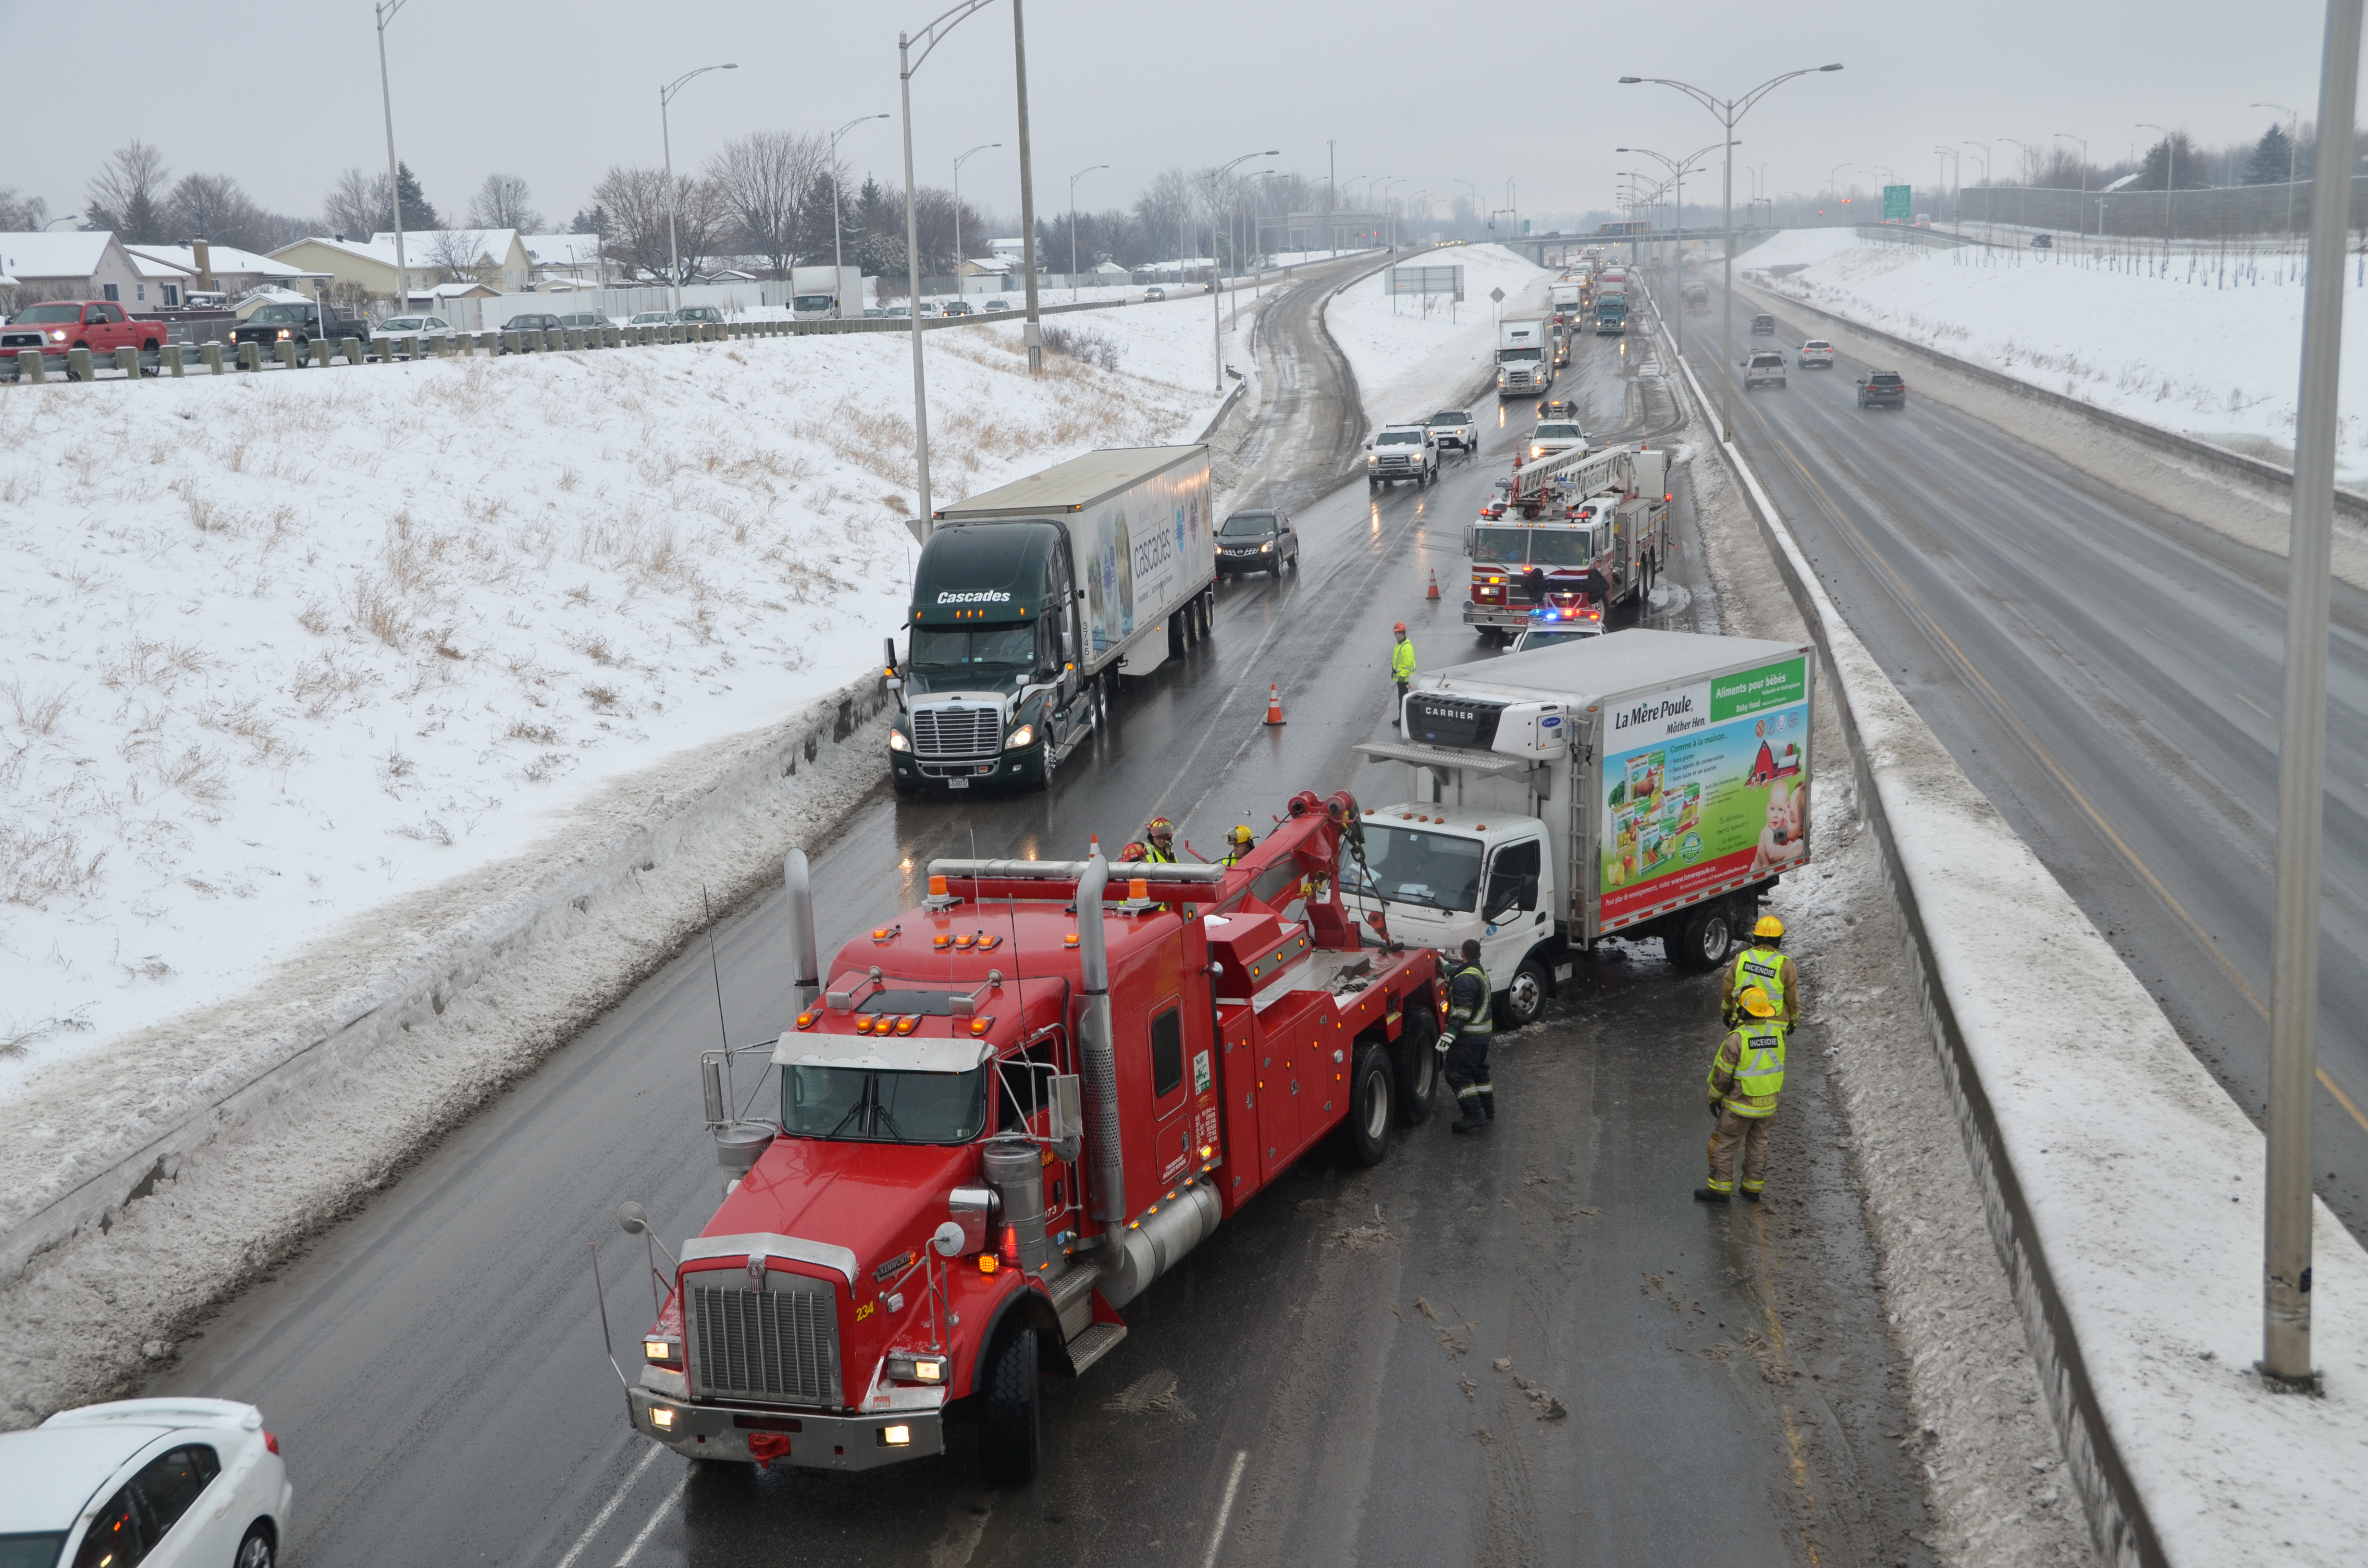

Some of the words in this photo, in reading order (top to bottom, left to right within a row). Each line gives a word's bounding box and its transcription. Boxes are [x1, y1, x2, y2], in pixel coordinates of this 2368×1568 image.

[1135, 521, 1172, 579] cascades
[937, 590, 1011, 604] Cascades
[1513, 617, 1528, 625] 420
[1716, 683, 1747, 698] Aliments
[1749, 679, 1764, 693] pour
[1765, 673, 1786, 686] bébés
[1616, 713, 1628, 729] La
[1630, 703, 1659, 726] Mère
[1660, 695, 1691, 718] Poule
[1736, 703, 1748, 712] Baby
[1749, 700, 1760, 709] food
[1425, 707, 1474, 721] CARRIER
[1666, 720, 1690, 735] Mother
[1692, 717, 1705, 728] Hen
[1670, 743, 1691, 753] Comme
[1698, 738, 1703, 746] la
[1682, 753, 1694, 762] gluten
[1701, 754, 1724, 764] conservation
[1703, 765, 1716, 773] ajoutés
[1671, 866, 1715, 885] www.lamerepoule.ca
[1714, 865, 1748, 879] www.motherhen.com
[1744, 963, 1776, 977] INCENDIE
[1750, 1037, 1777, 1047] INCENDIE
[1166, 1153, 1184, 1171] TRANSPORT
[879, 1253, 912, 1275] KENWORTH
[856, 1300, 874, 1322] 234
